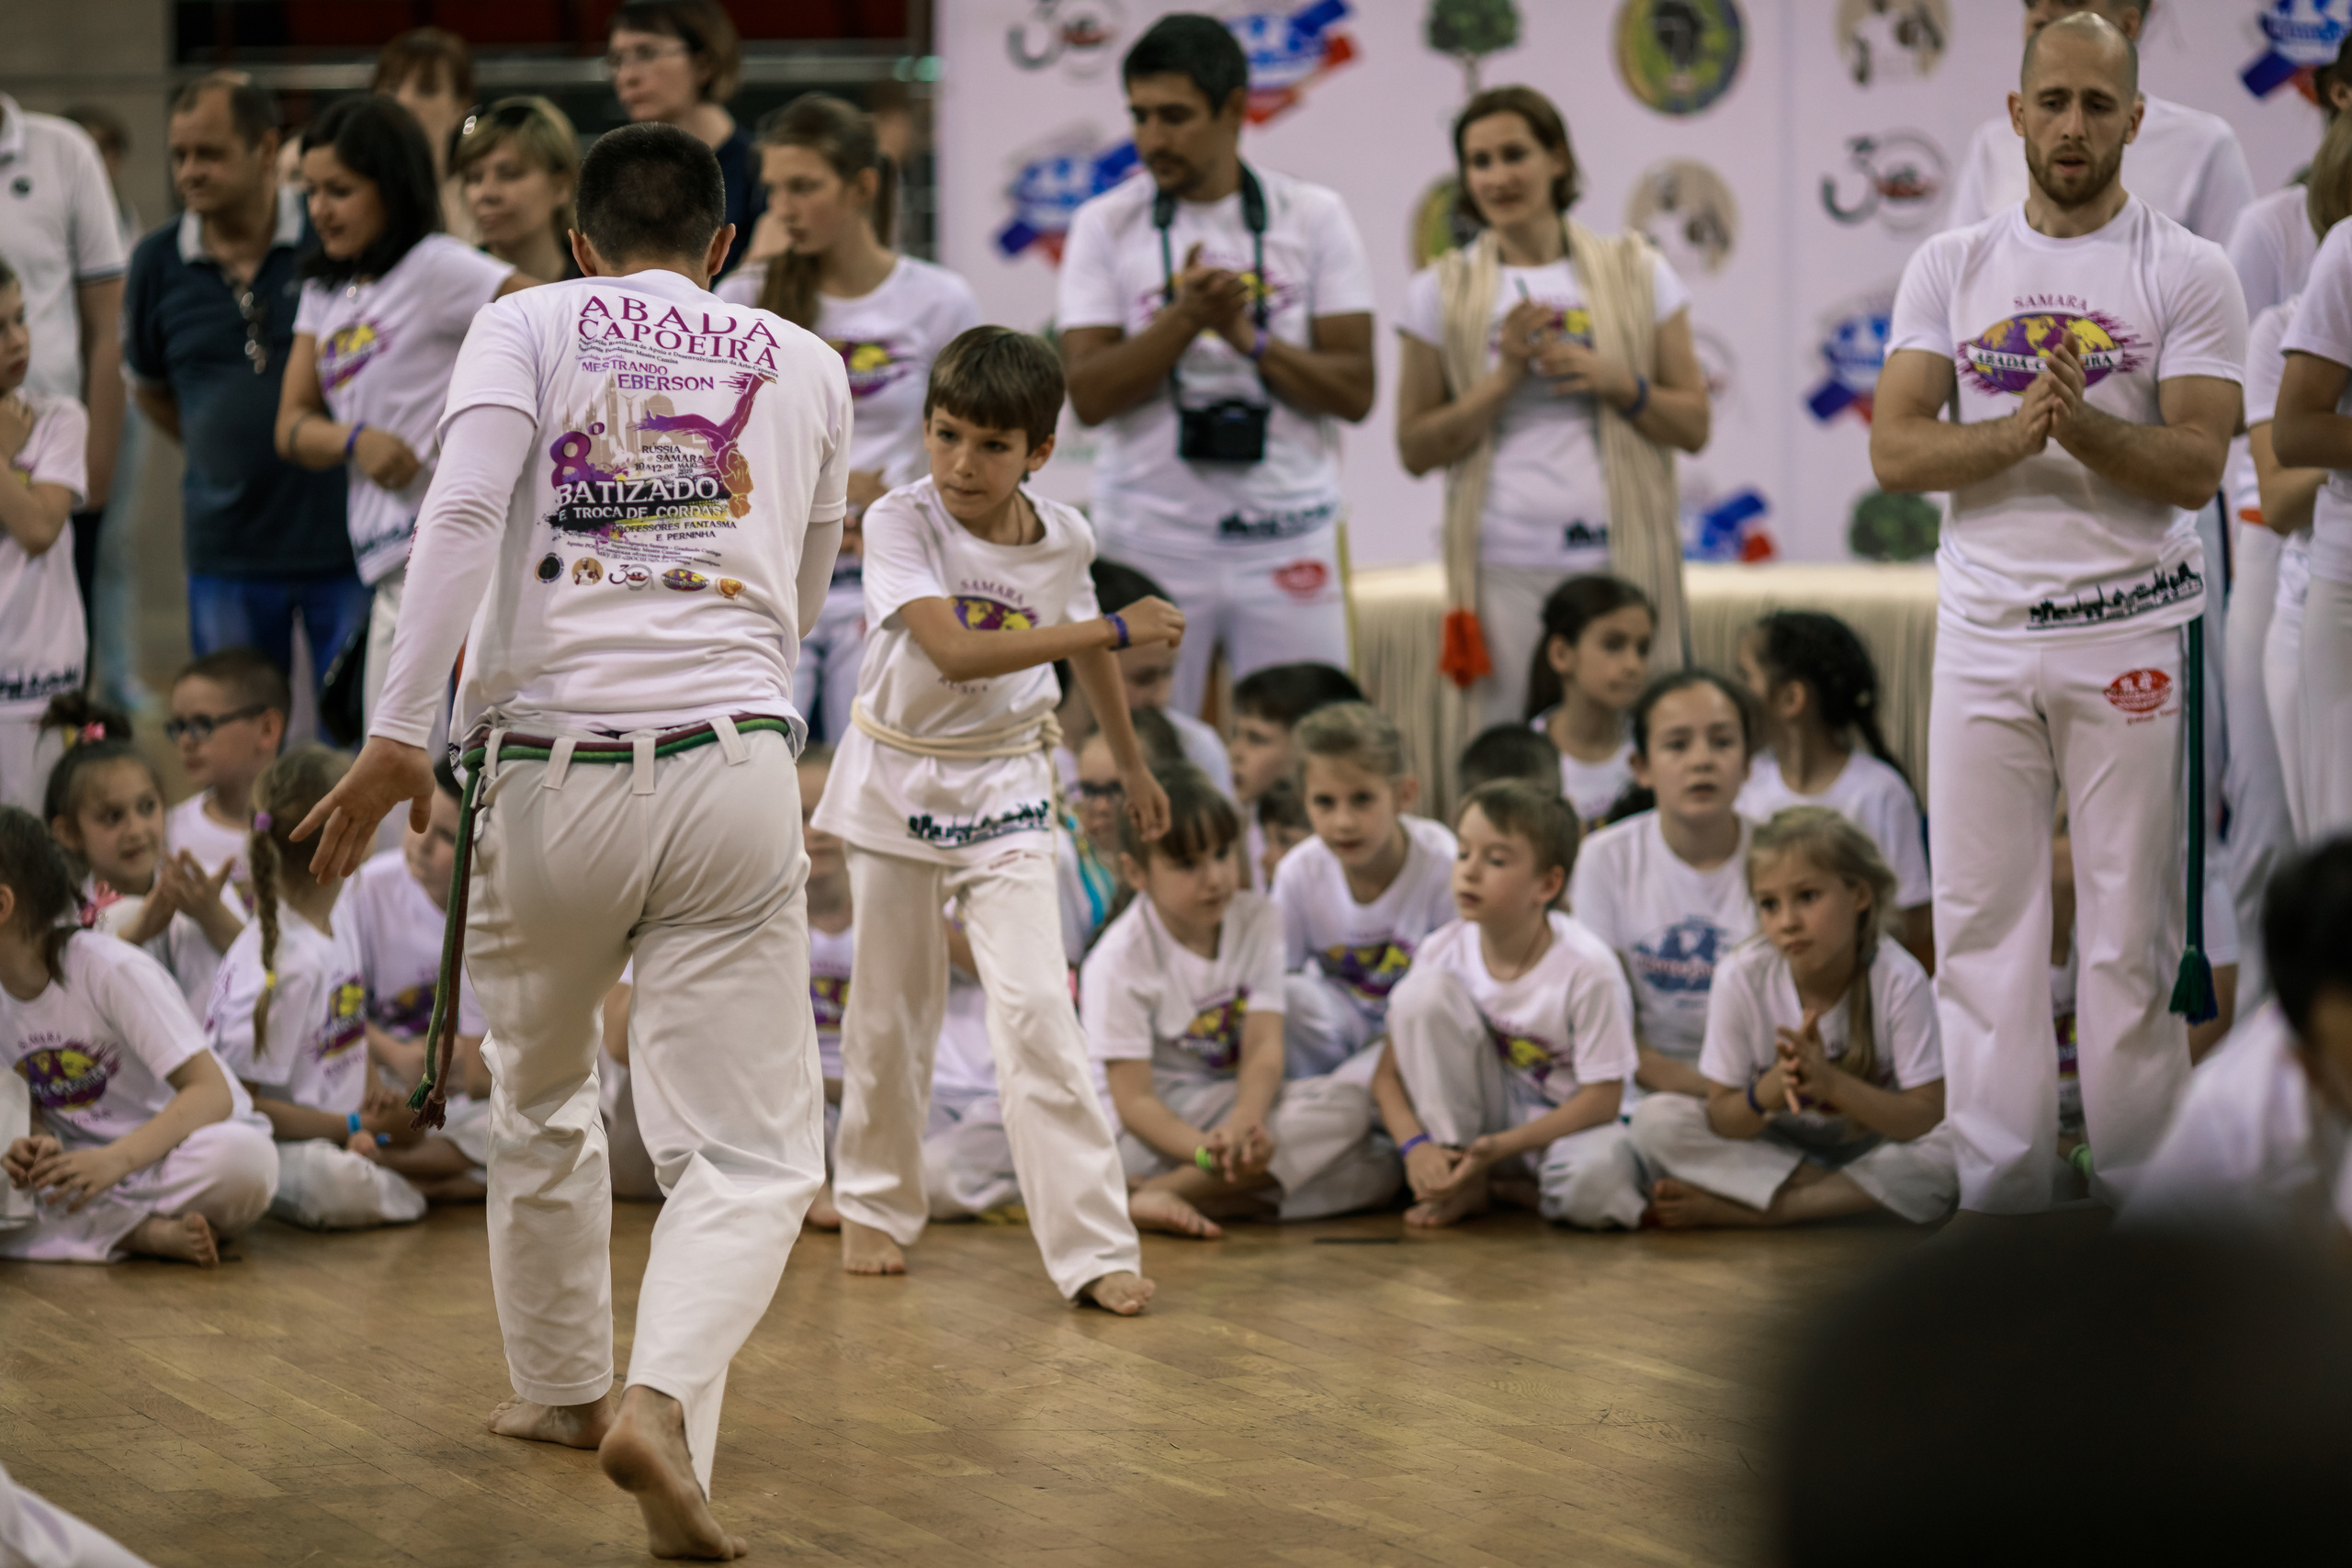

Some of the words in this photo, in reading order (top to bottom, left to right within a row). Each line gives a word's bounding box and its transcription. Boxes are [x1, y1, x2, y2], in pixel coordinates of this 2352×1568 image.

[2014, 293, 2088, 310] SAMARA
[578, 319, 778, 371] CAPOEIRA
[608, 339, 639, 348] Brasileira
[648, 345, 666, 356] Apoio
[673, 351, 728, 364] Desenvolvimento
[635, 349, 656, 360] Mestre
[656, 355, 679, 365] Camisa
[582, 359, 668, 376] MESTRANDO
[617, 373, 715, 391] EBERSON
[655, 454, 706, 463] SAMARA
[555, 476, 719, 506] BATIZADO
[559, 508, 568, 522] E
[572, 506, 624, 520] TROCA
[627, 506, 649, 520] DE
[655, 505, 723, 519] CORDAS
[611, 523, 680, 534] PROFESSORES
[684, 520, 737, 530] FANTASMA
[656, 534, 663, 542] E
[666, 530, 717, 541] PERNINHA
[960, 579, 1024, 605] SAMARA
